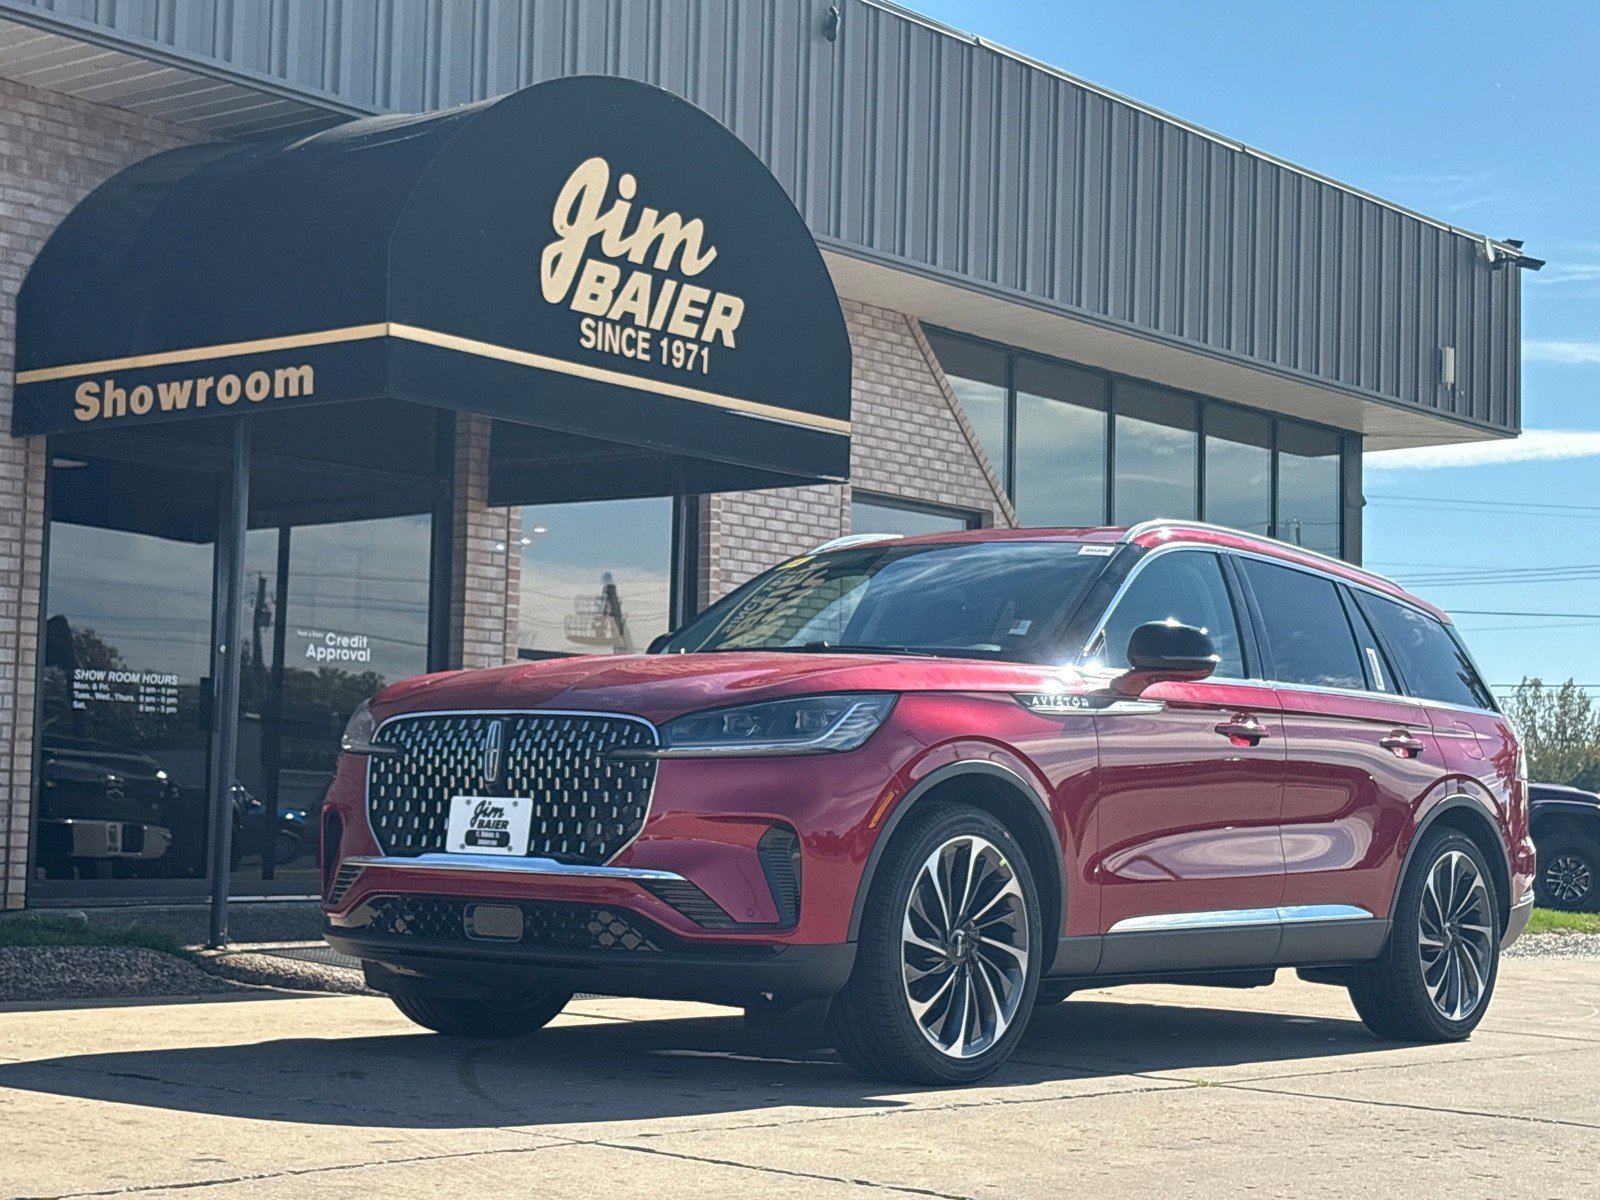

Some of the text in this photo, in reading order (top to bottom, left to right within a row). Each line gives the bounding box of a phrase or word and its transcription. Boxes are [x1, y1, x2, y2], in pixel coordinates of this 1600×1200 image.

[541, 157, 717, 304] Jim
[570, 259, 744, 348] BAIER
[580, 317, 709, 374] SINCE 1971
[74, 365, 314, 421] Showroom
[325, 632, 368, 648] Credit
[305, 643, 370, 662] Approval
[74, 669, 178, 685] SHOW ROOM HOURS
[1032, 695, 1089, 707] AVIATOR
[470, 800, 504, 828] Jim
[477, 820, 509, 830] BAIER
